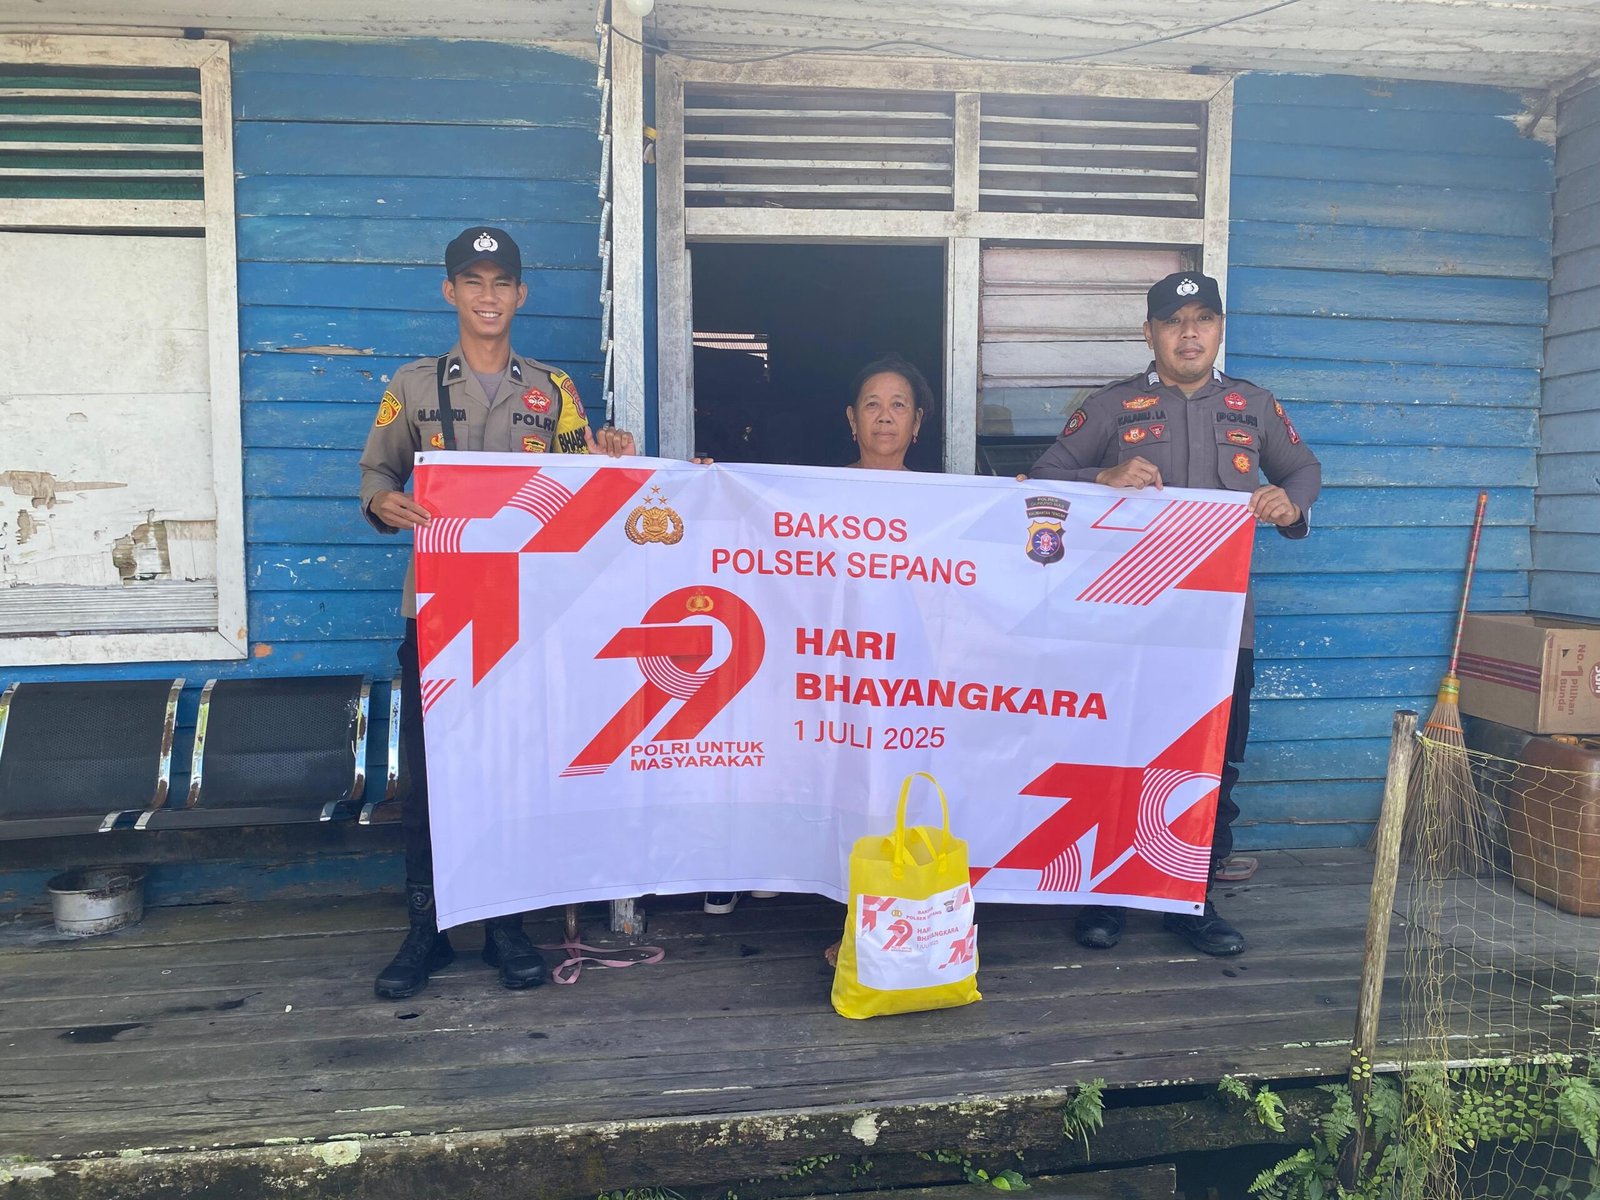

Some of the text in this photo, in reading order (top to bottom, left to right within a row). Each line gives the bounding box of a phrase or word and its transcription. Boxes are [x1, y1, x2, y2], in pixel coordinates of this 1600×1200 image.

[512, 412, 556, 432] POLRI
[1216, 411, 1259, 428] POLRI
[774, 512, 908, 543] BAKSOS
[712, 547, 977, 587] POLSEK SEPANG
[796, 627, 897, 662] HARI
[796, 671, 1108, 721] BHAYANGKARA
[1558, 678, 1568, 712] Bunda
[630, 740, 764, 757] POLRI UNTUK
[794, 719, 946, 751] 1 JULI 2025
[630, 754, 765, 772] MASYARAKAT
